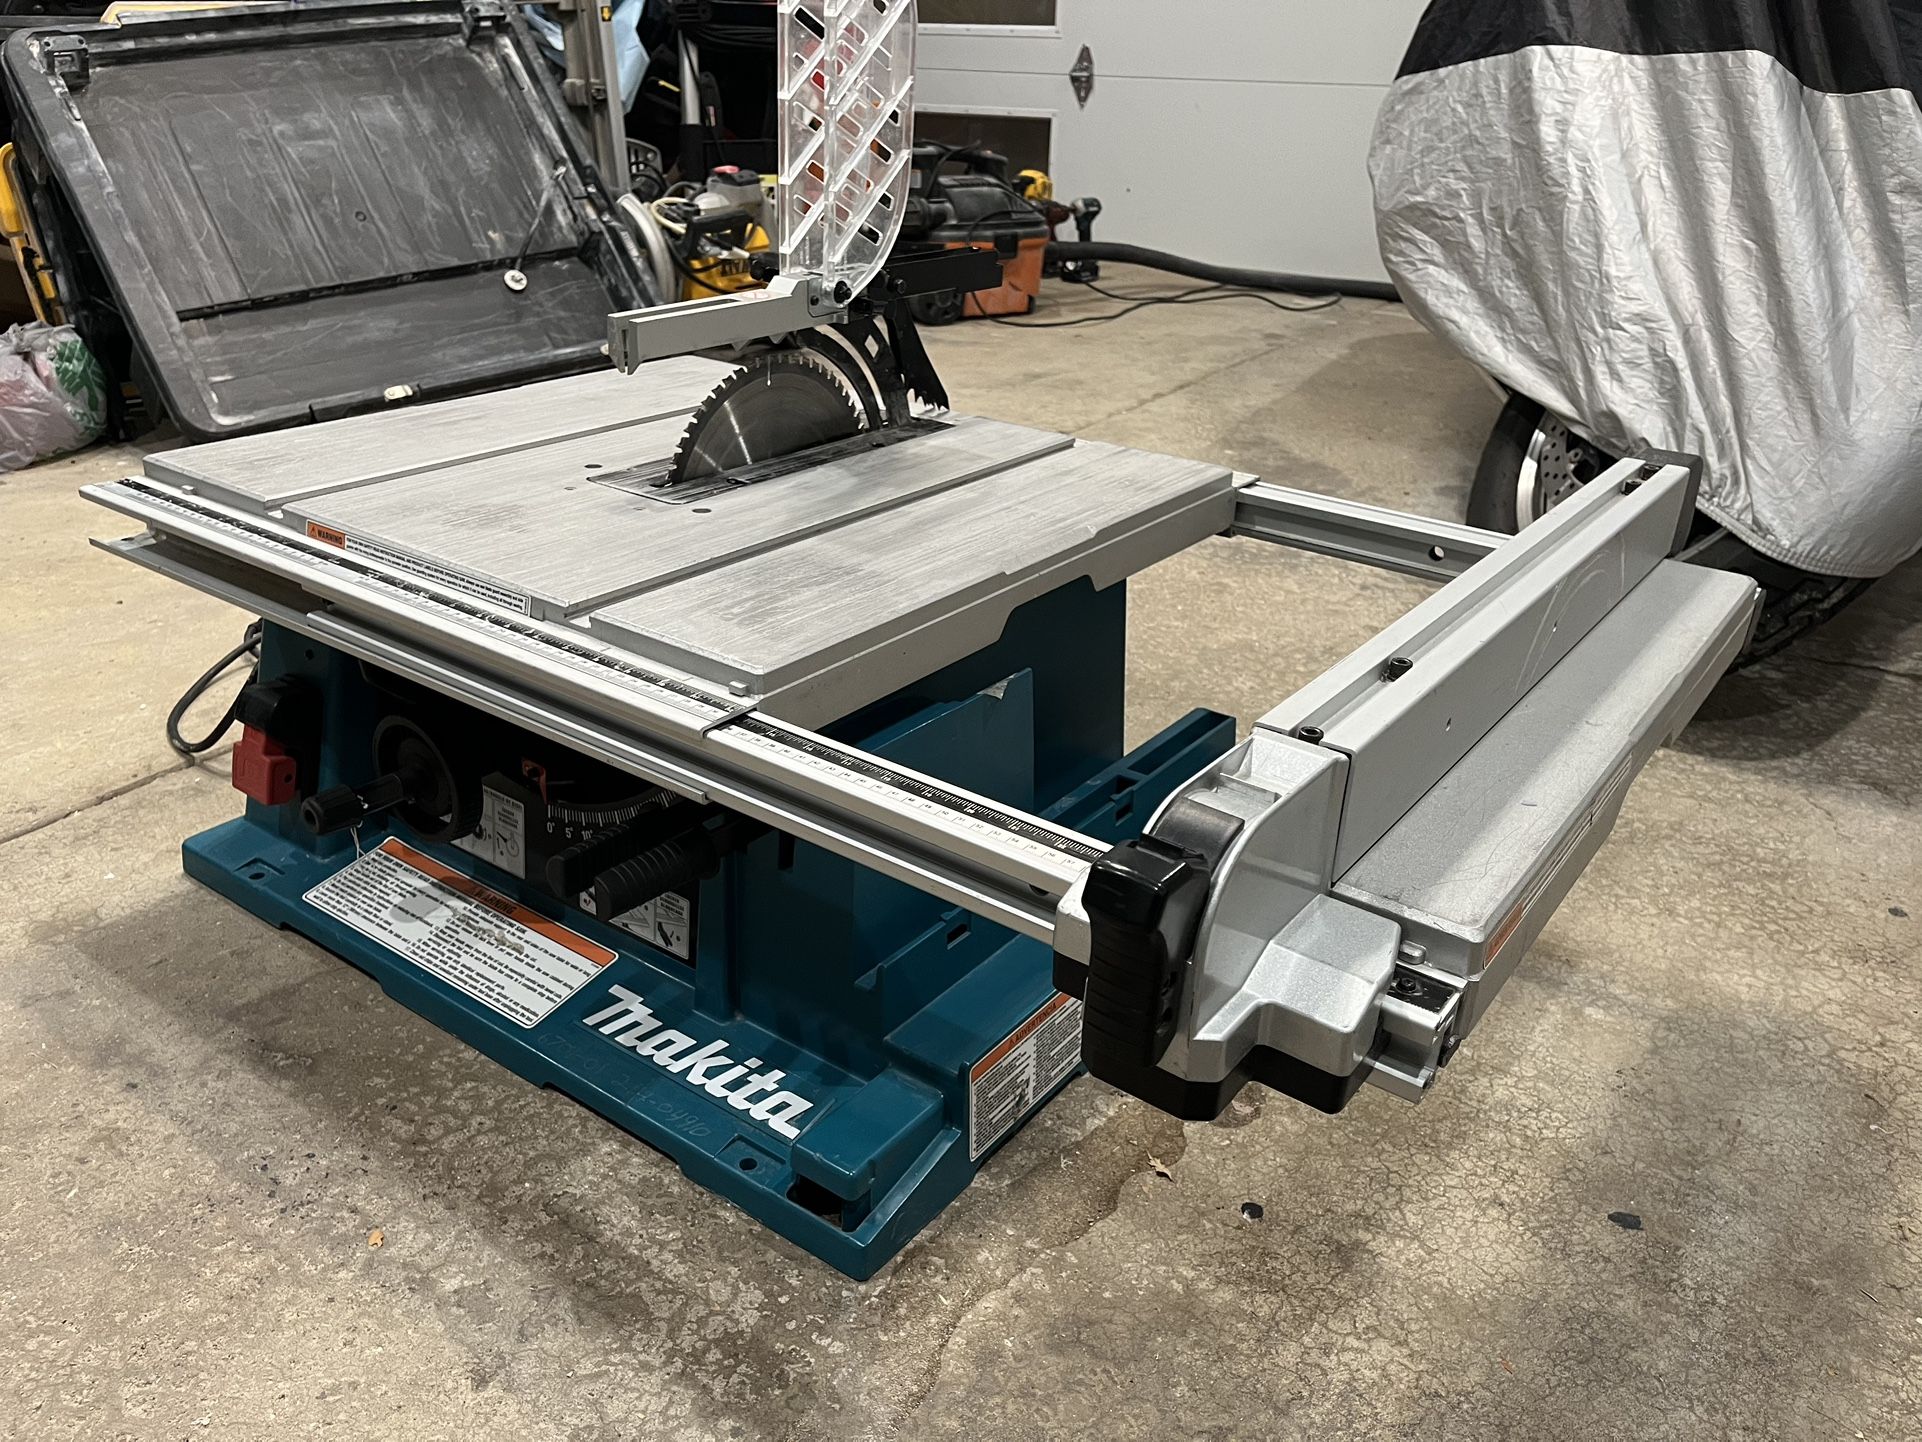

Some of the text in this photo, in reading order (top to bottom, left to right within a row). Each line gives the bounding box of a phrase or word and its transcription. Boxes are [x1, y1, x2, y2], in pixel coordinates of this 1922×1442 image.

[317, 528, 343, 546] WARNING
[475, 888, 517, 915] WARNING
[1014, 1002, 1057, 1042] ADVERTENCIA
